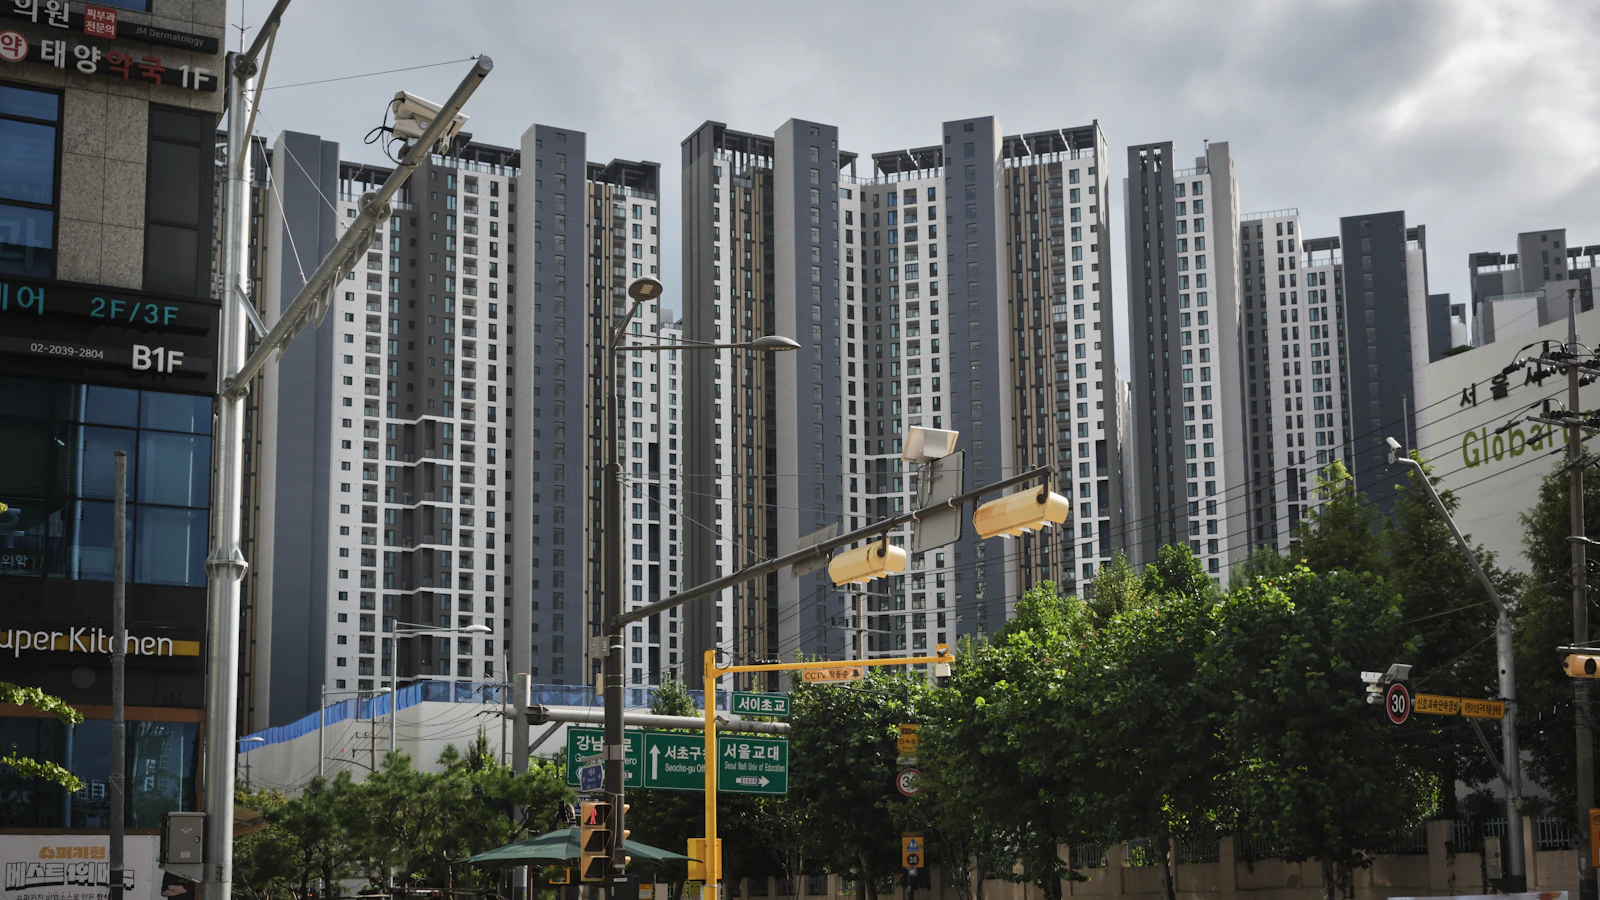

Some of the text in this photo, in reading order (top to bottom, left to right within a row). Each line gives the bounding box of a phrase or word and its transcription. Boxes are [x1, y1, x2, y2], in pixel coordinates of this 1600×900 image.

[86, 8, 116, 23] 피부과
[86, 20, 115, 36] 전문의
[135, 26, 204, 47] JM Dermatology
[1, 34, 22, 57] 약
[179, 64, 211, 91] 1F
[90, 297, 179, 326] 2F/3F
[30, 342, 104, 360] 02-2039-2804
[132, 344, 185, 374] B1F
[1462, 419, 1553, 469] Global
[804, 671, 827, 680] CCTV
[738, 696, 786, 712] 서이초교
[1391, 693, 1406, 714] 30
[576, 734, 634, 753] 강남로
[664, 744, 706, 761] 서초구
[723, 743, 780, 762] 서울교대
[664, 762, 696, 775] Seocho-gu
[724, 760, 737, 770] Seoul
[748, 762, 758, 771] Univ
[759, 762, 764, 772] of
[764, 763, 786, 773] Education
[38, 845, 106, 860] 슈퍼키친
[908, 856, 918, 864] 30
[5, 862, 65, 892] 베스트
